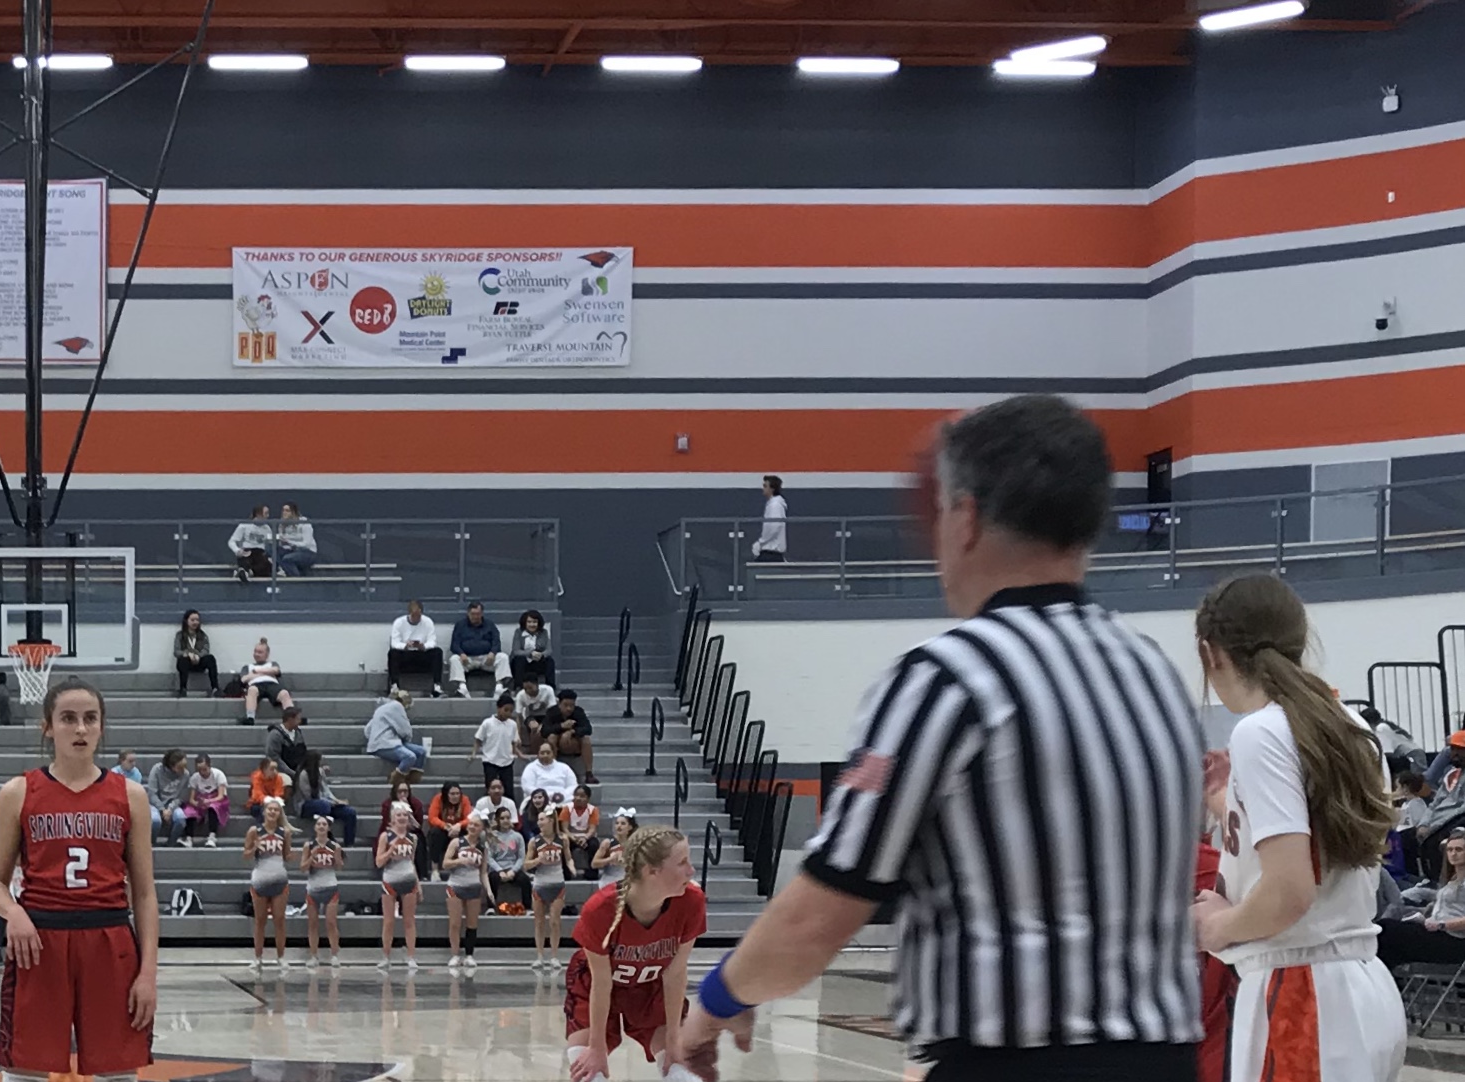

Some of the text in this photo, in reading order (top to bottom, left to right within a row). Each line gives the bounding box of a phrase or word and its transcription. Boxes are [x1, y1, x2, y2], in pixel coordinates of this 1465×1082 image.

[244, 252, 563, 262] THANKS TO OUR GENEROUS SKYRIDGE SPONSORS!!
[507, 268, 532, 277] Utah
[261, 269, 349, 291] ASPEN
[497, 274, 571, 290] Community
[563, 301, 625, 310] Swensen
[562, 311, 625, 324] Software
[506, 343, 613, 352] TRAVERSE MOUNTAIN
[28, 811, 125, 843] SPRINGVILLE
[65, 847, 90, 888] 2
[612, 964, 663, 984] 20
